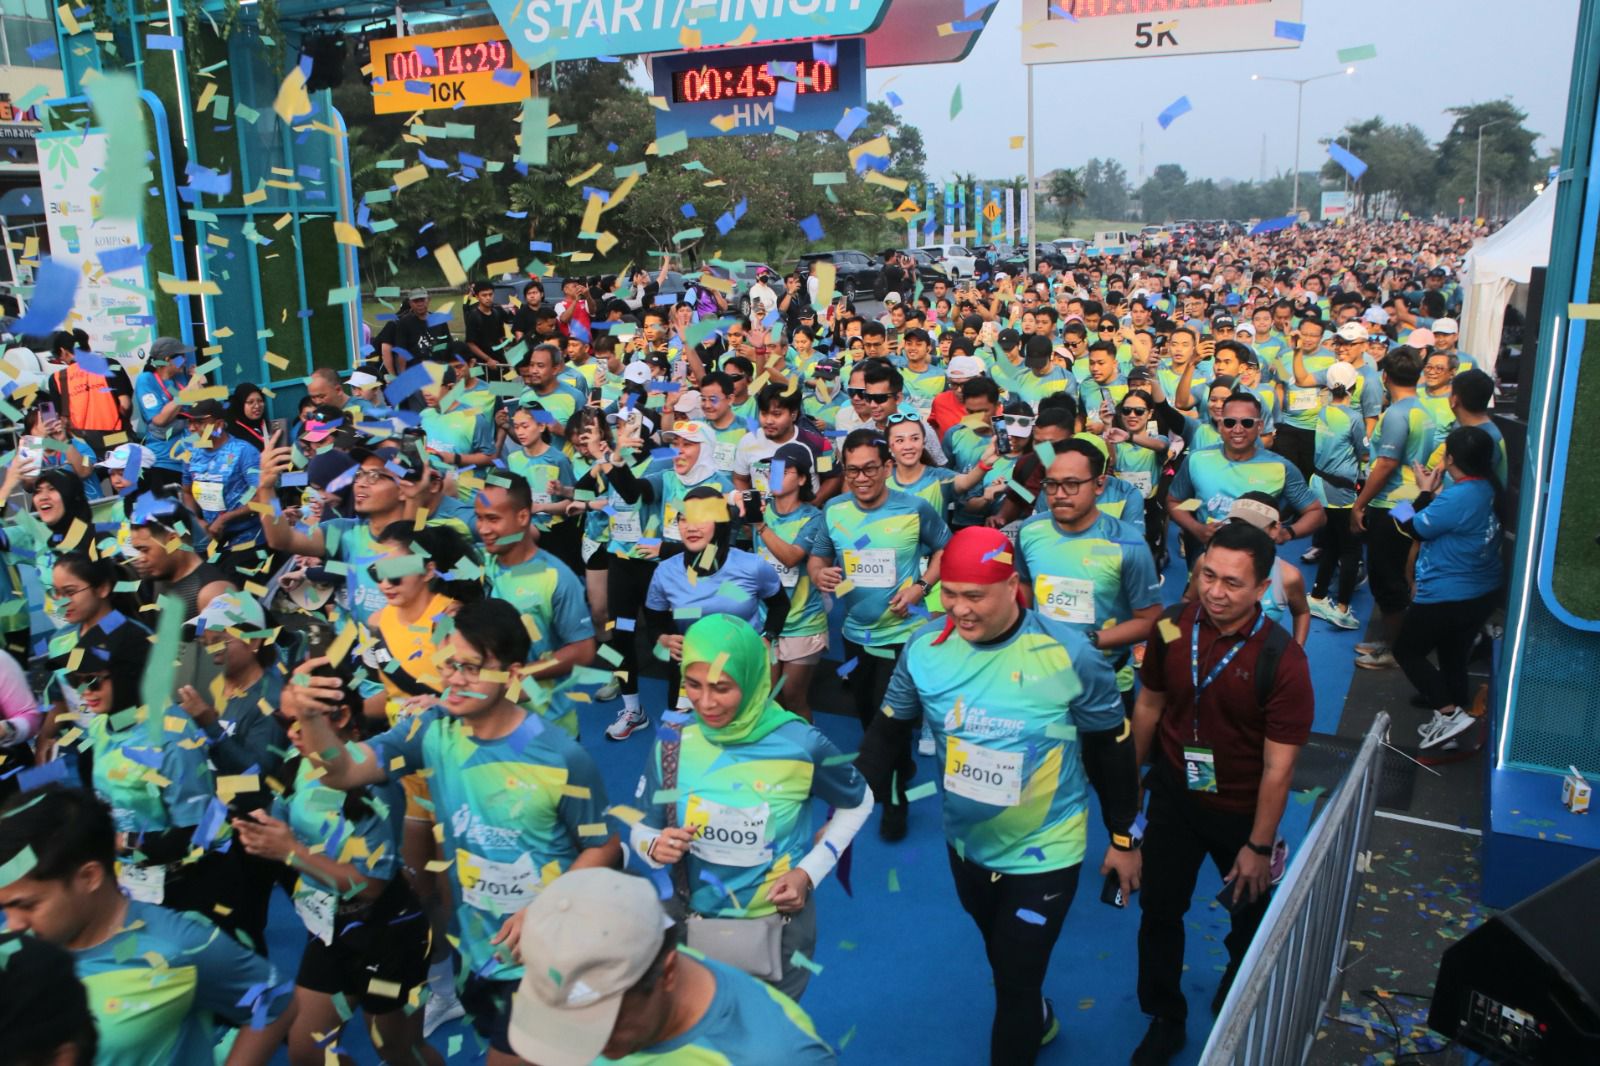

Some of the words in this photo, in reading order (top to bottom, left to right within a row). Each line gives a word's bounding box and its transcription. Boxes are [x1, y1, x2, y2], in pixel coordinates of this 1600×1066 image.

[1135, 21, 1179, 48] 5K
[430, 81, 466, 102] 10K
[683, 60, 832, 101] 00:4510
[733, 102, 774, 127] HM
[850, 563, 884, 574] J8001
[1047, 593, 1078, 608] 8621
[953, 760, 1003, 787] J8010
[1187, 761, 1200, 783] VIP
